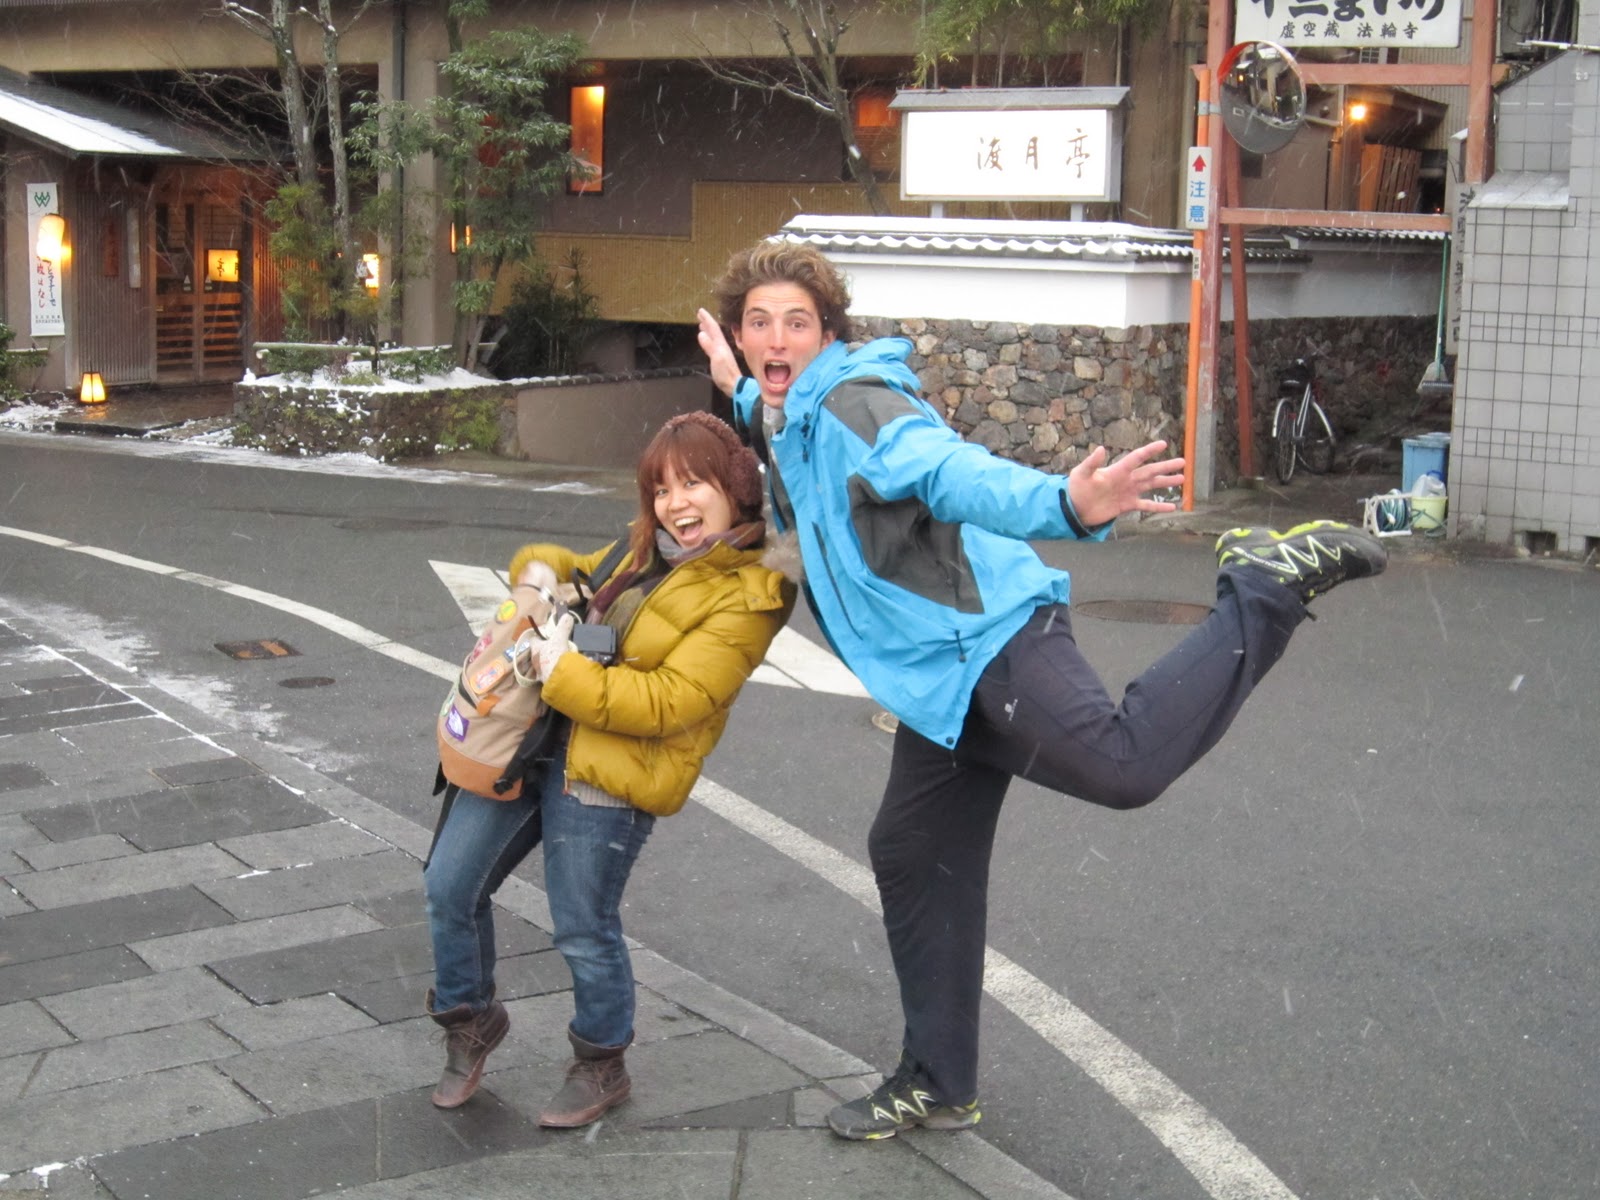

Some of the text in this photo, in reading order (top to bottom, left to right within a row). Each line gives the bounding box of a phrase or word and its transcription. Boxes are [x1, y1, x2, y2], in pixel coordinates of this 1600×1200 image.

[1356, 22, 1418, 39] 法輪寺
[977, 128, 1090, 178] 渡月亭
[1189, 180, 1206, 223] 注意
